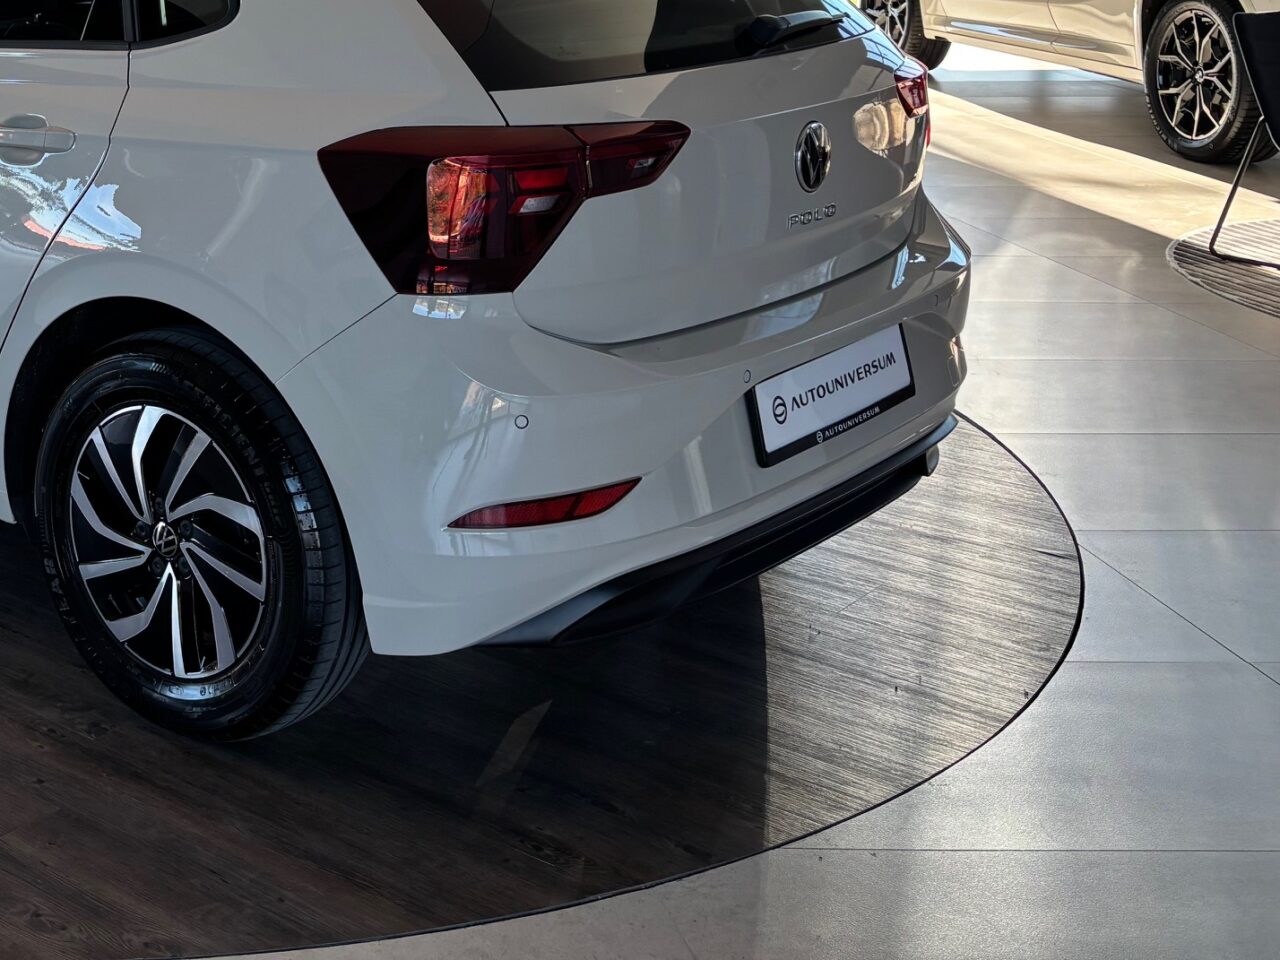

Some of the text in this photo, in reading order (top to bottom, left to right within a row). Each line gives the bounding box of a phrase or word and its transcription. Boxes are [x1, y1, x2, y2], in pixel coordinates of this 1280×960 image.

[785, 202, 838, 231] POLO
[790, 351, 897, 412] AUTOUNIVERSUM
[824, 405, 881, 440] AUTOUNIVERSUM
